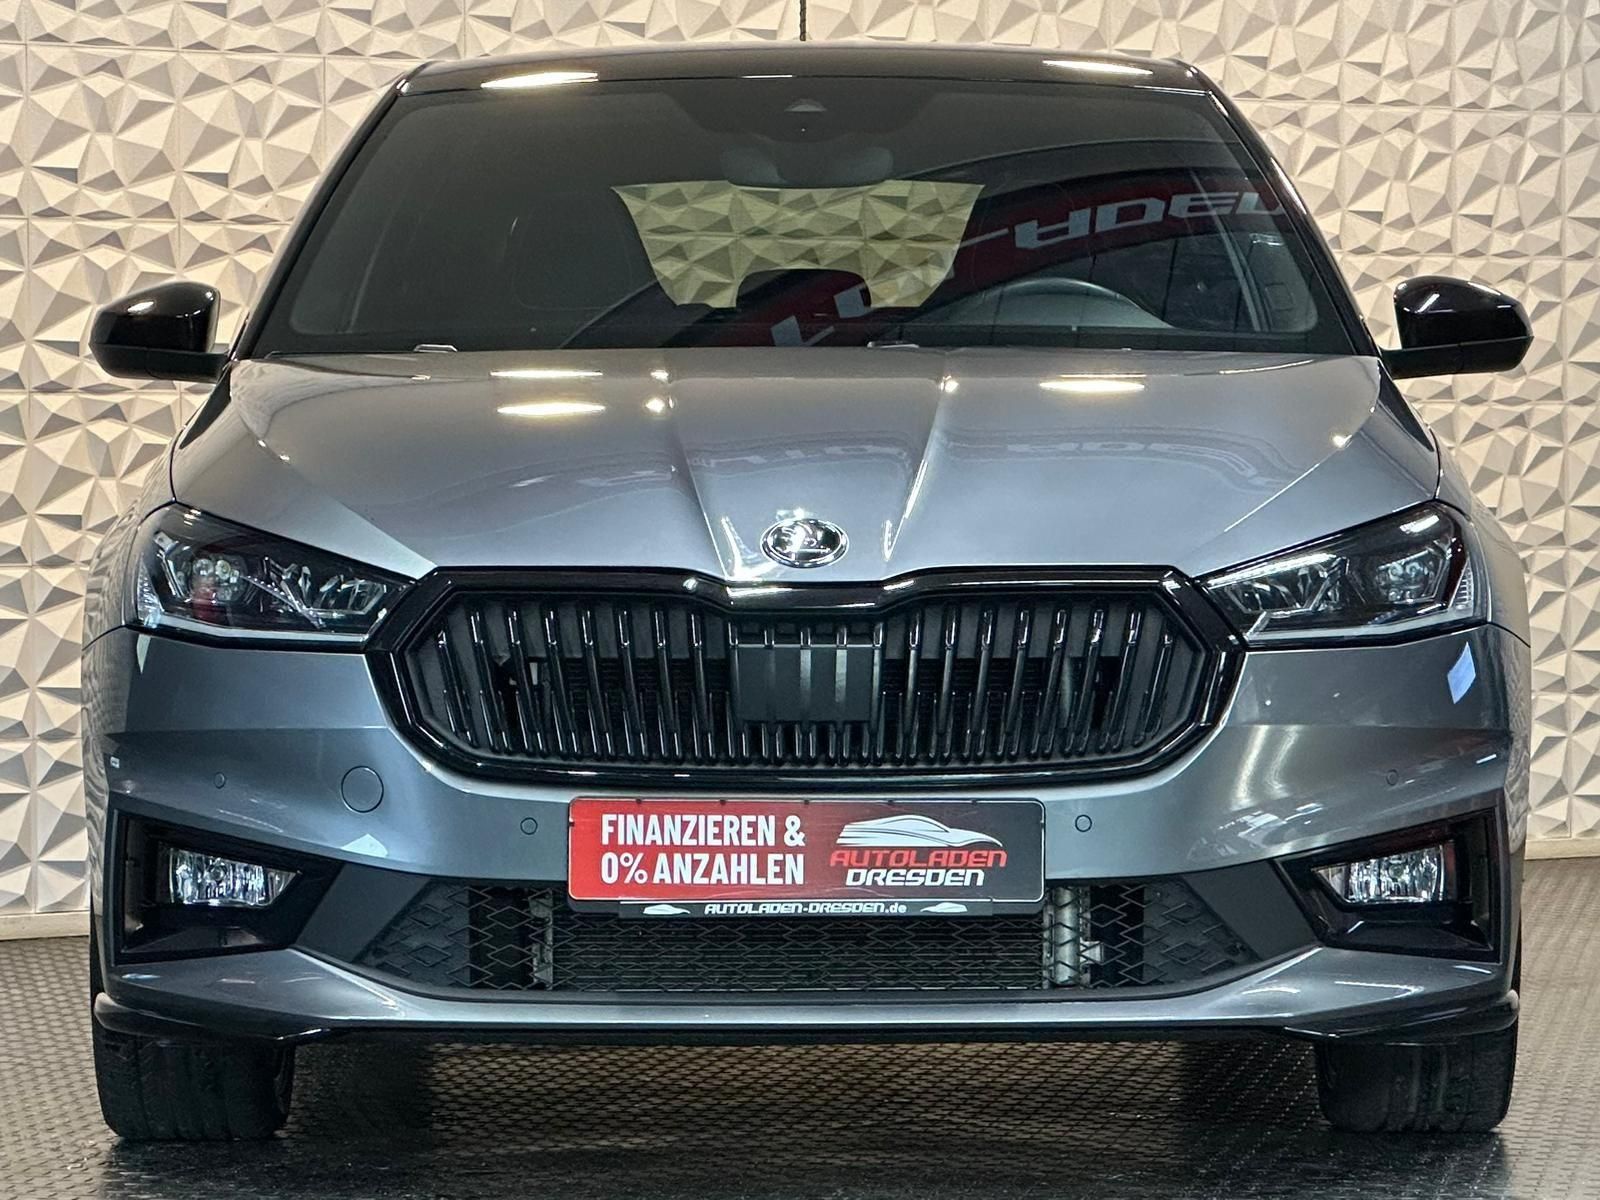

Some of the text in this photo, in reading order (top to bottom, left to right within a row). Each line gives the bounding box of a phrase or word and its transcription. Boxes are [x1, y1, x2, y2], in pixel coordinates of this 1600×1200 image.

[601, 813, 806, 847] FINANZIEREN &
[601, 851, 805, 885] 0% ANZAHLEN
[829, 849, 1008, 868] AUTOLADEN
[845, 868, 985, 887] DRESDEN
[703, 902, 908, 915] AUTOLADEN-DRESDEN.de
